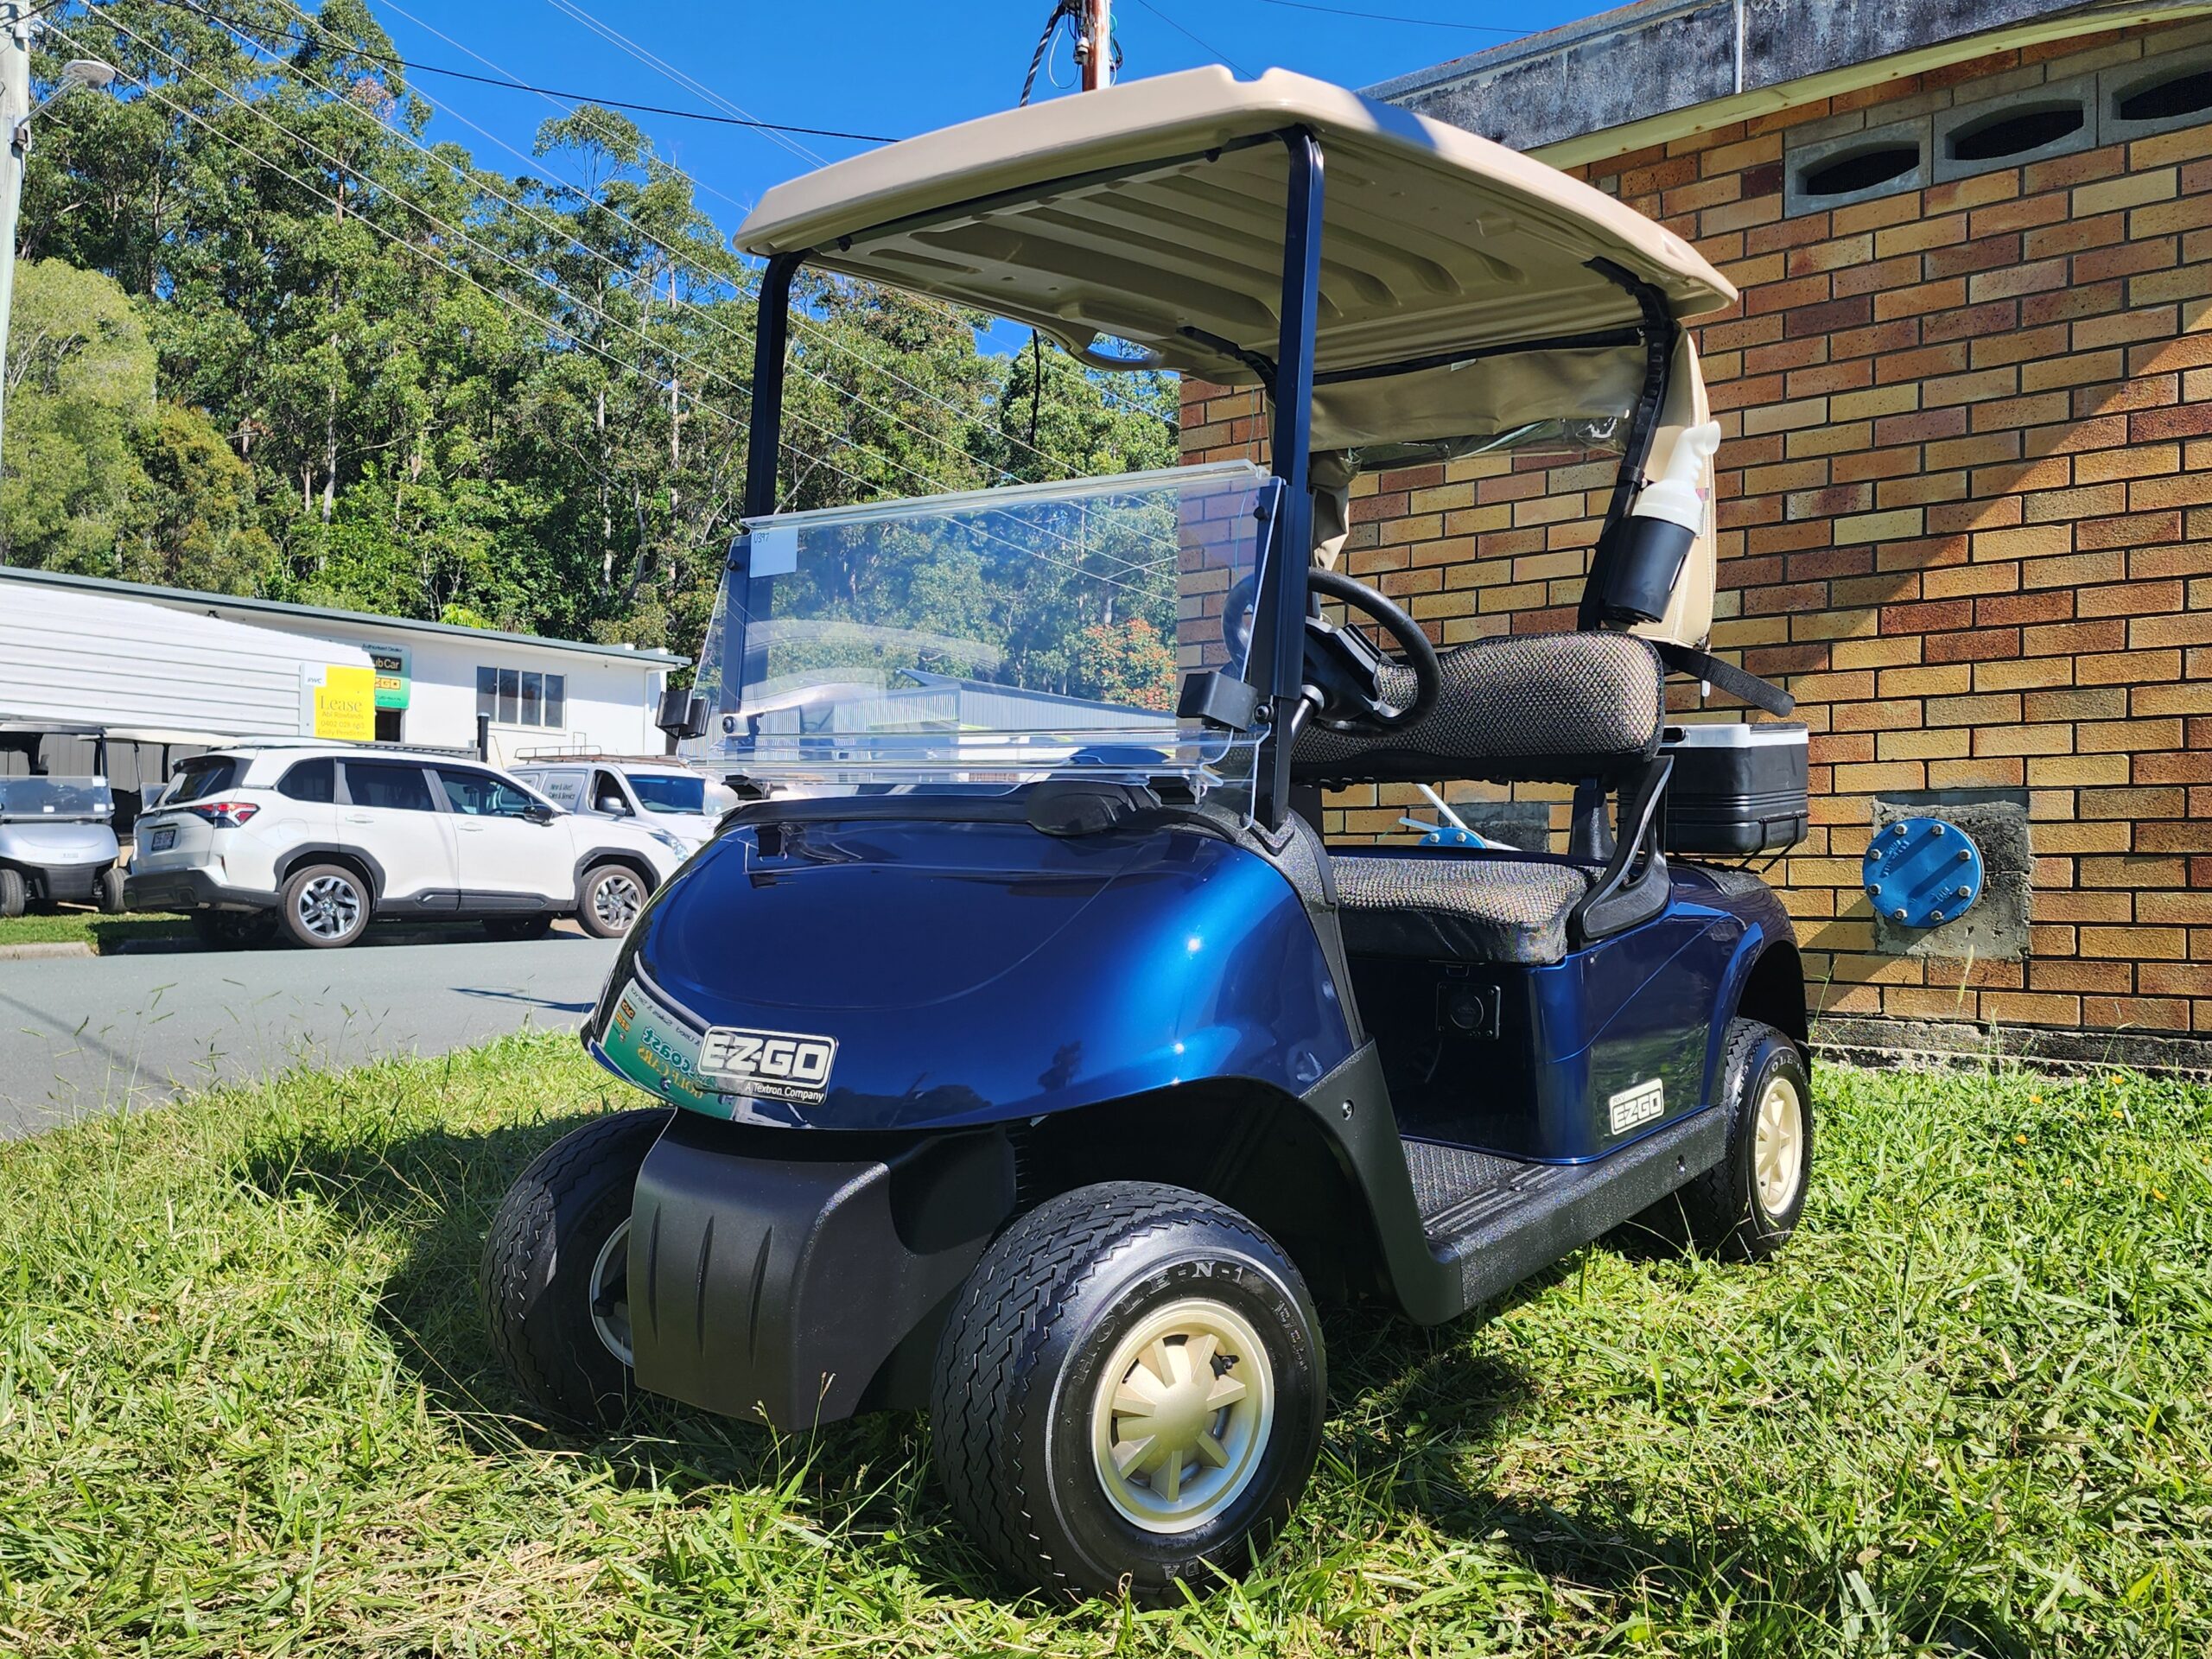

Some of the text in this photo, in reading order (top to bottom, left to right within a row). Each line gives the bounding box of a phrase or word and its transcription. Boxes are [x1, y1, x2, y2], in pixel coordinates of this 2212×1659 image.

[384, 658, 399, 670] Car
[320, 695, 363, 713] Lease
[704, 1033, 830, 1080] EZGO
[745, 1082, 825, 1103] A Textron Company
[1612, 1094, 1625, 1103] RXV
[1613, 1090, 1662, 1129] EZGO
